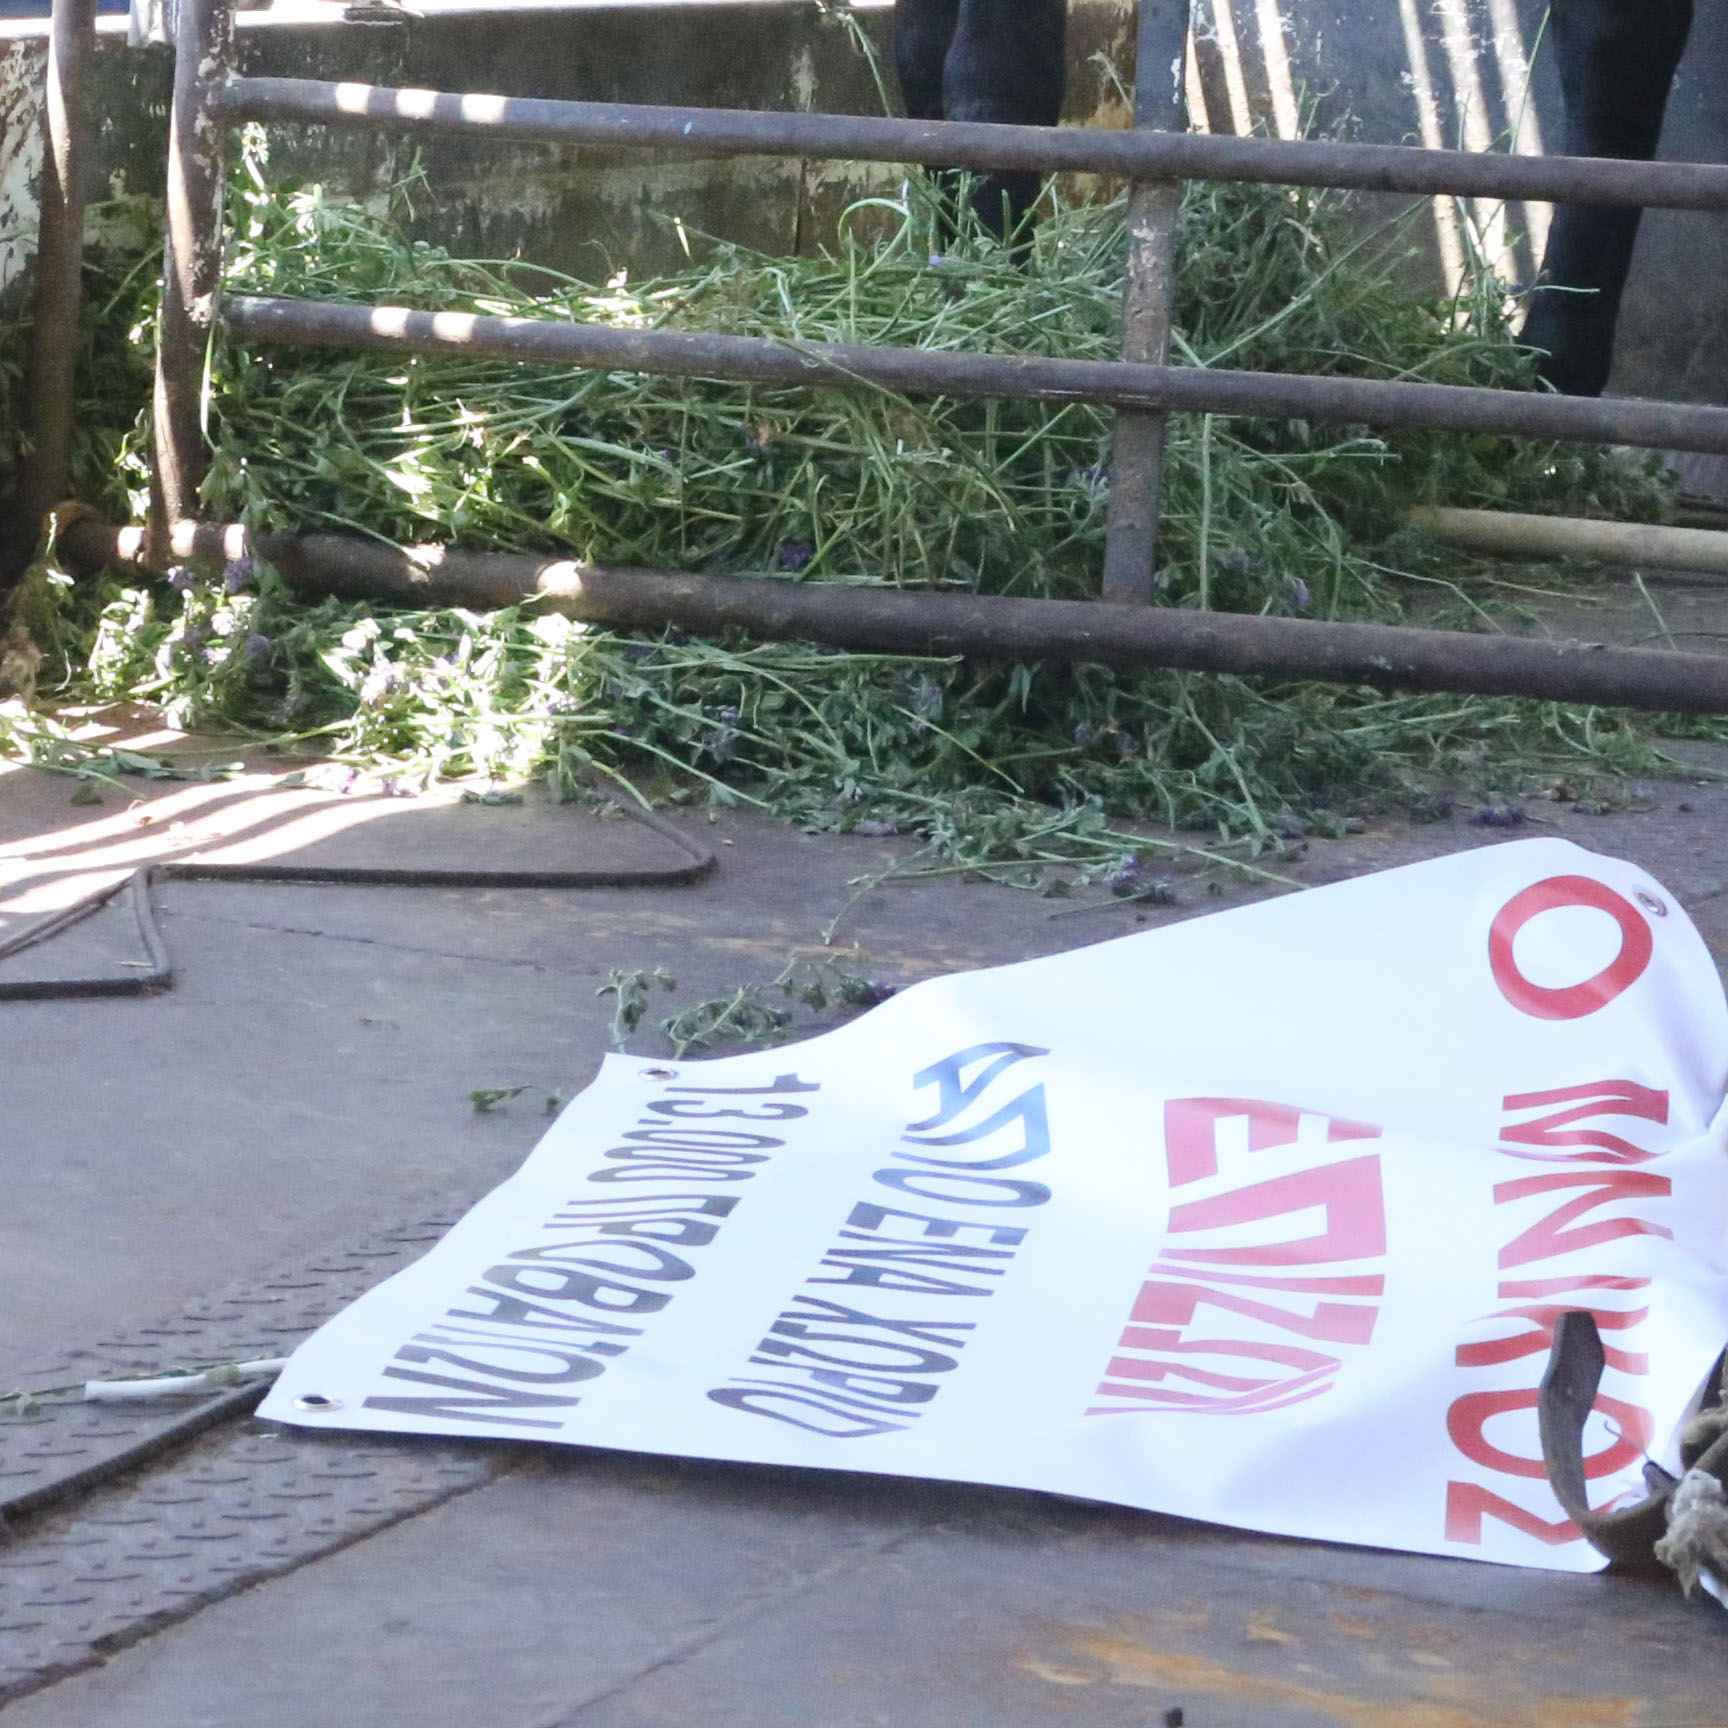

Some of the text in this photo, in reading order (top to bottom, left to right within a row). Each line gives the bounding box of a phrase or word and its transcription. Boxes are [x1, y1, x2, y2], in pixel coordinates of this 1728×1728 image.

[1488, 874, 1654, 1021] Ο
[361, 1072, 821, 1430] 13.000 ΠΡΟΒΑΤΩΝ
[705, 1041, 1052, 1438] ΑΠΟ ΕΝΑ ΧΩΡΙΟ
[1083, 1096, 1387, 1416] ΕΠΙΖΩΝ
